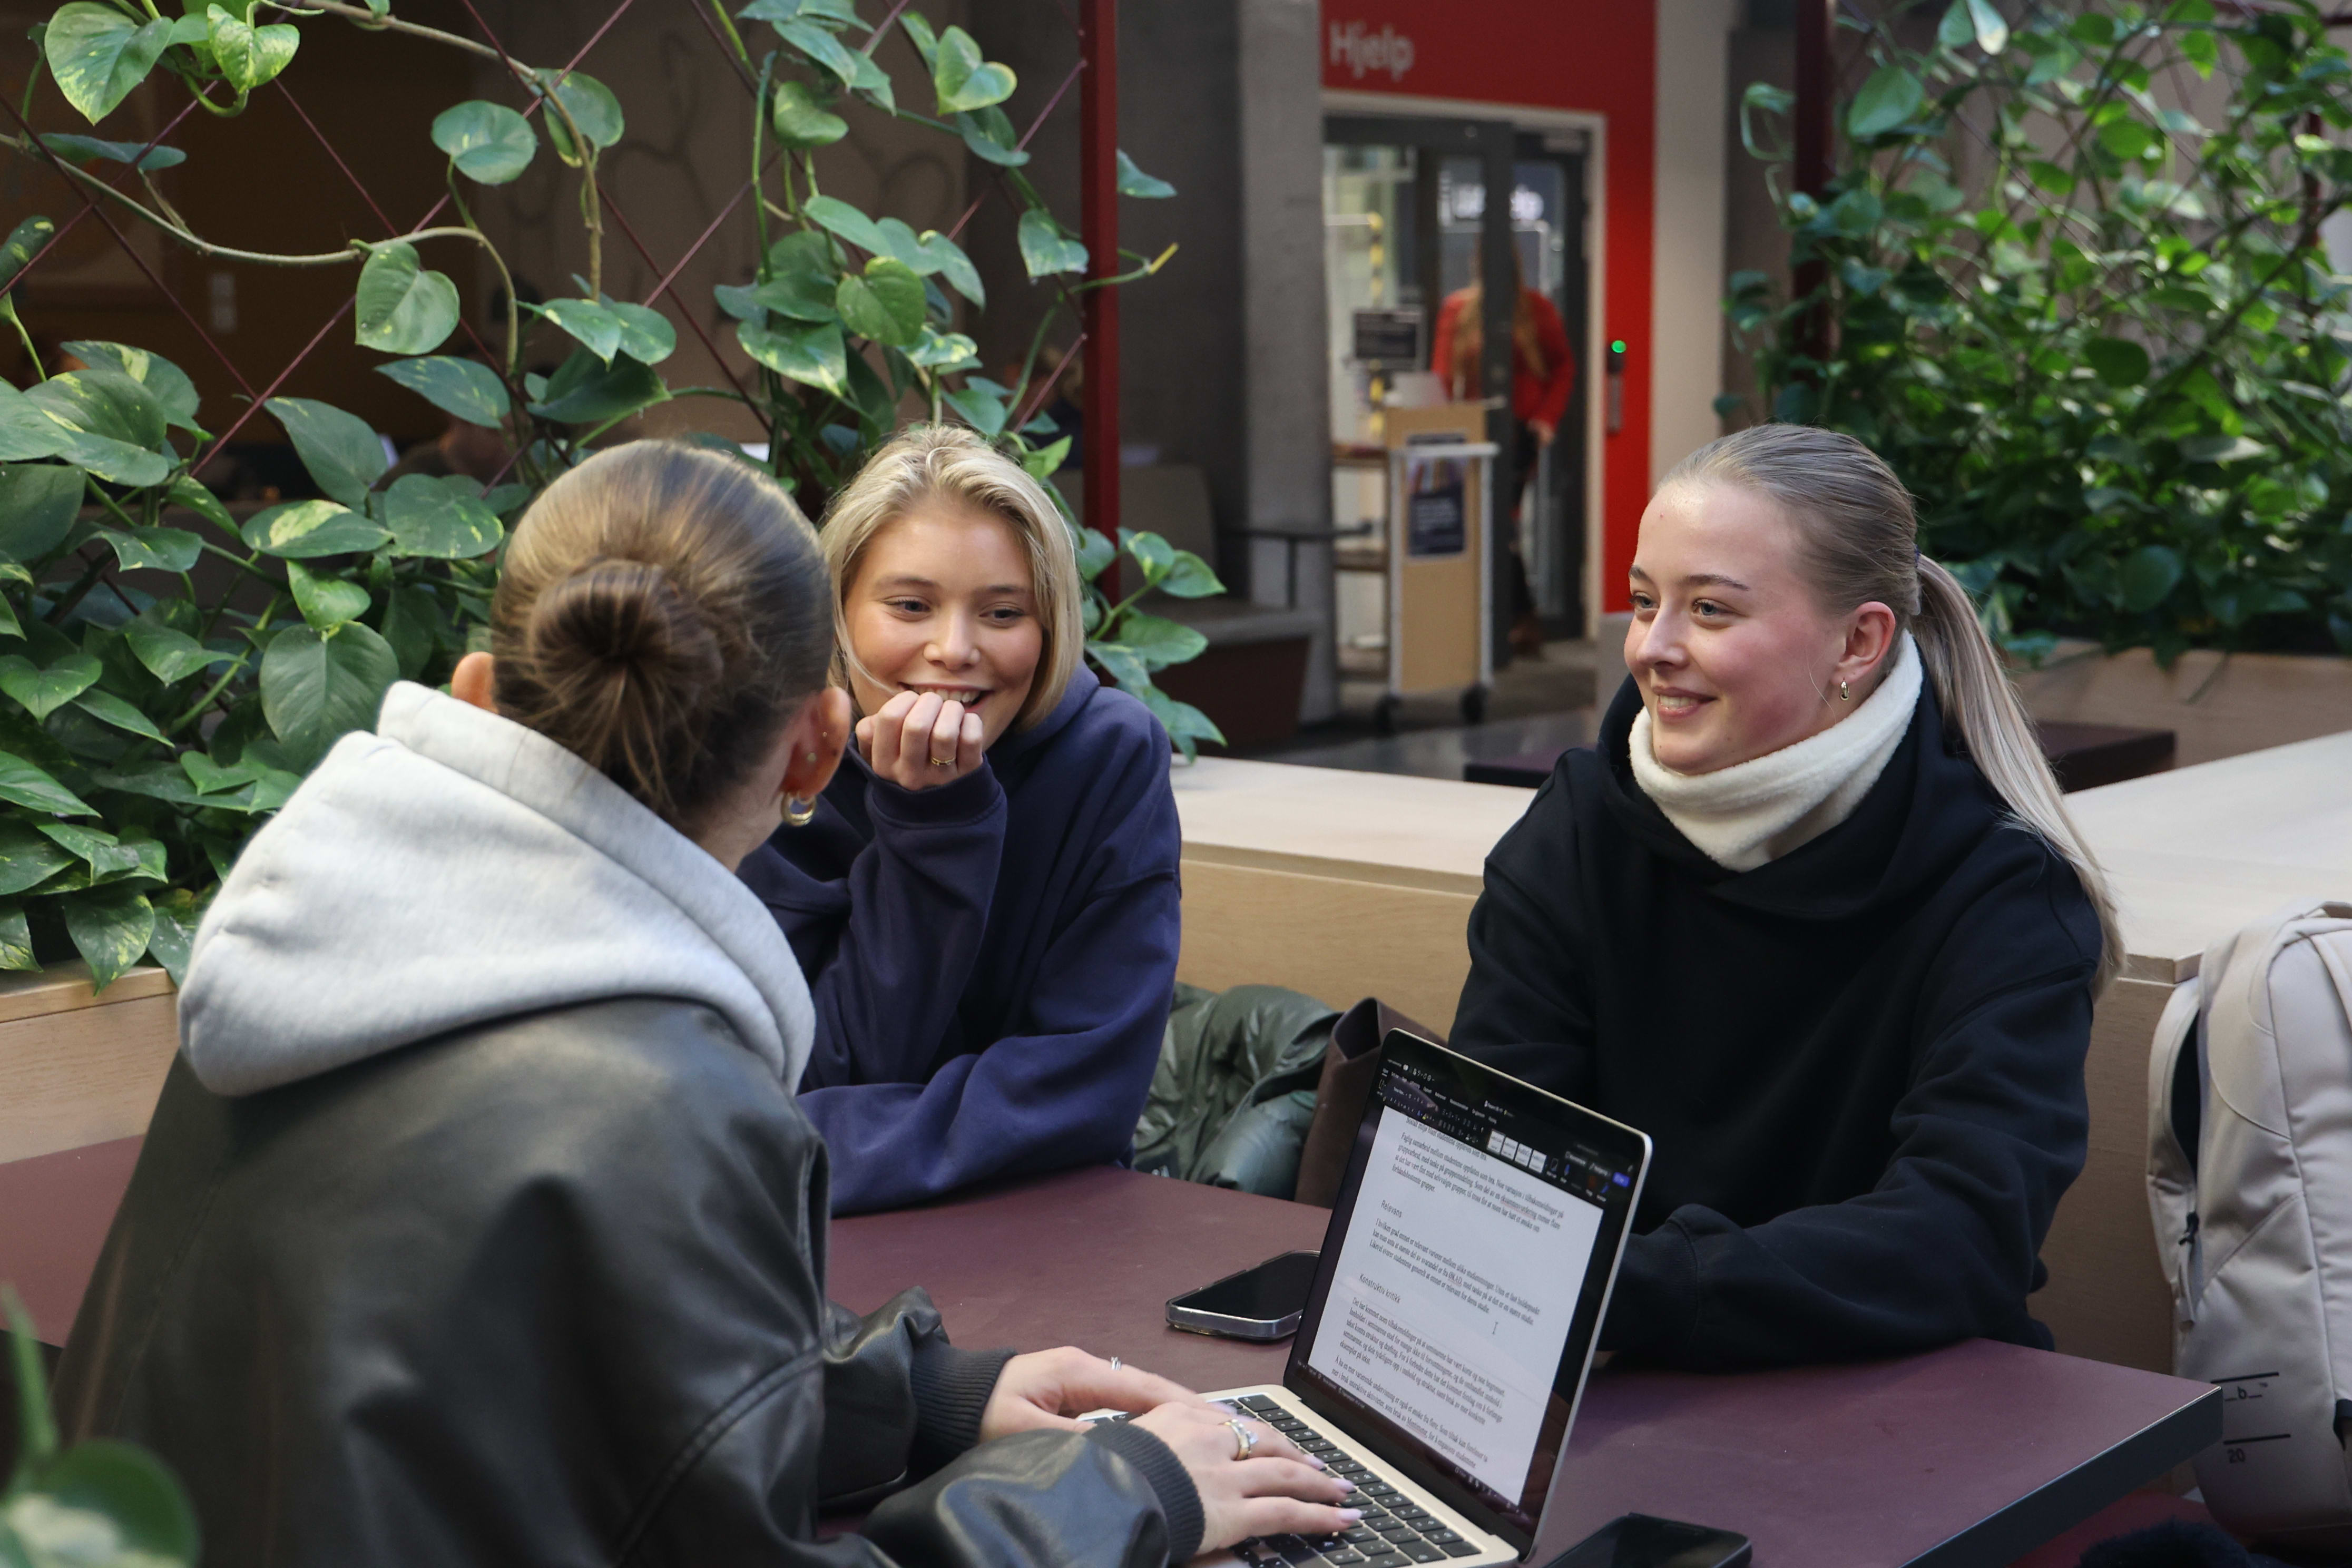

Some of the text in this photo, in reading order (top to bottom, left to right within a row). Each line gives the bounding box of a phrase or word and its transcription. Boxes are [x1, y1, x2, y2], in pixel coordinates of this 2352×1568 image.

[1330, 20, 1415, 82] Hjelp
[1381, 1200, 1402, 1218] Relevans
[1359, 1273, 1400, 1304] Konstruktiv kritikk
[2228, 1448, 2246, 1464] 20
